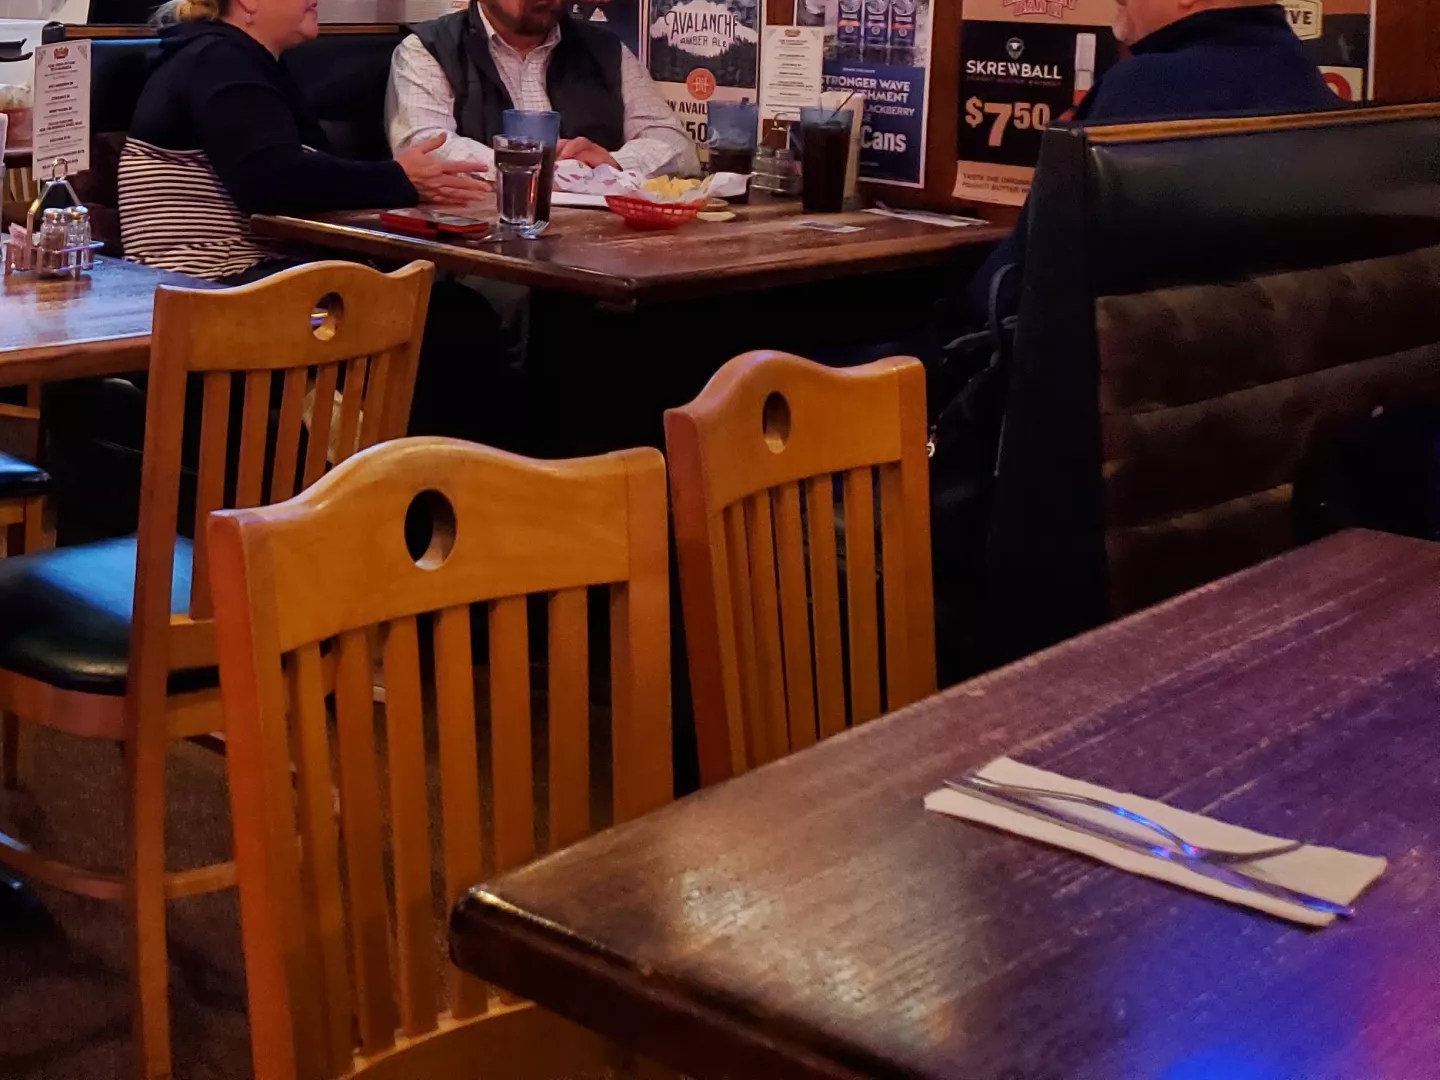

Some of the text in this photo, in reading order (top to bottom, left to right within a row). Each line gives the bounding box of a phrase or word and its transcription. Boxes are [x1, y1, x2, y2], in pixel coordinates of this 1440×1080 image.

[664, 11, 738, 41] AVALANCHE
[679, 35, 708, 47] AMBER
[966, 60, 1063, 80] SKREWBALL
[879, 79, 911, 92] WAVE
[864, 105, 916, 116] LACKBERRY
[861, 125, 907, 153] Cans
